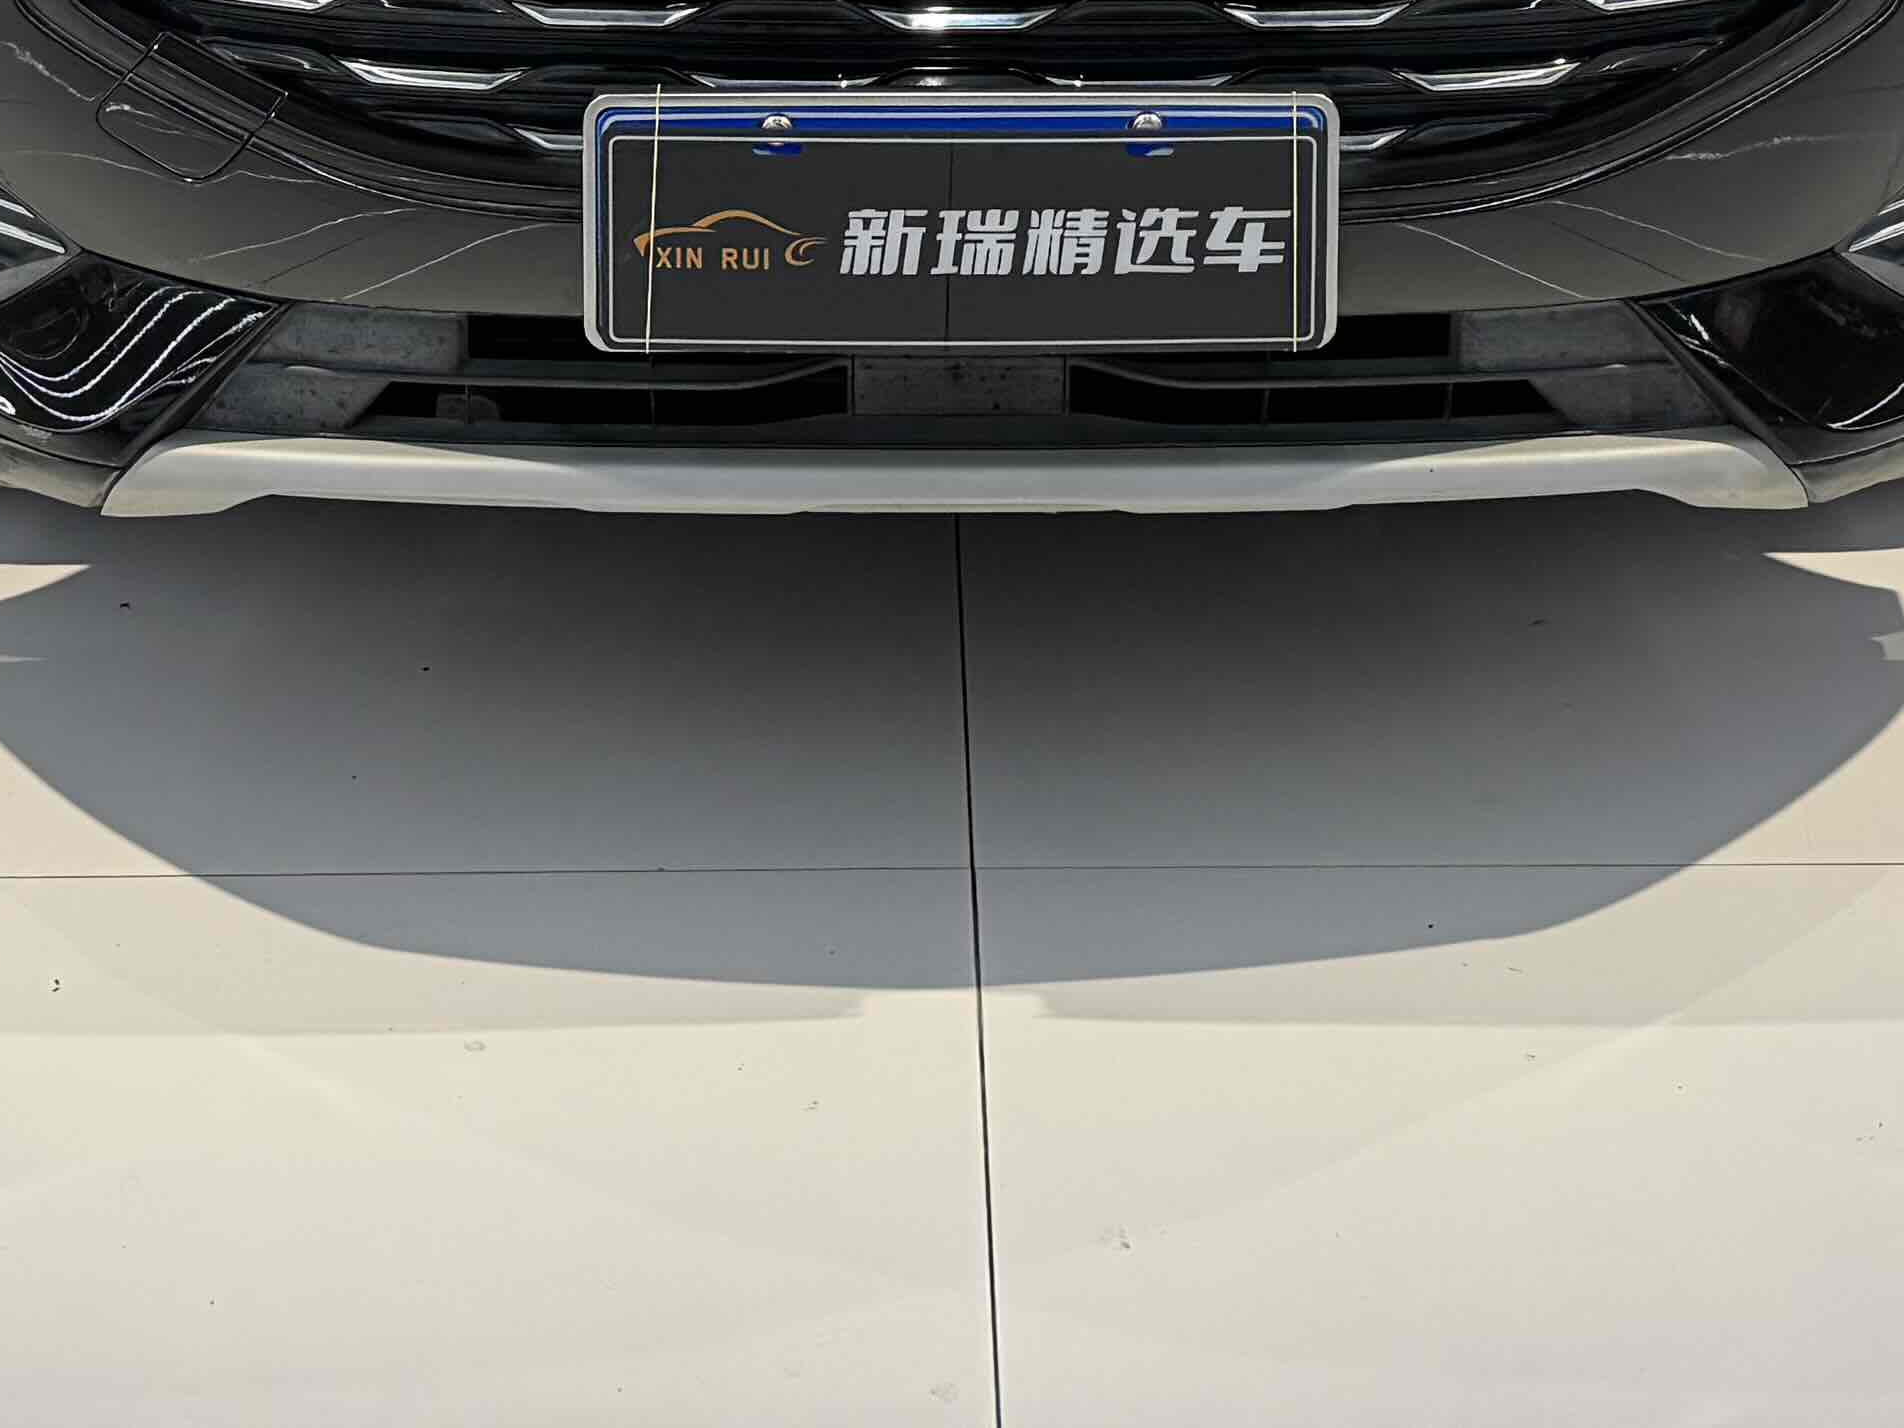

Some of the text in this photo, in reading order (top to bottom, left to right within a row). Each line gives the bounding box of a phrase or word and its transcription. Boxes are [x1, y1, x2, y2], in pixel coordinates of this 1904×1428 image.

[654, 245, 771, 271] XIN RUI
[838, 206, 1293, 277] 新瑞精选车
